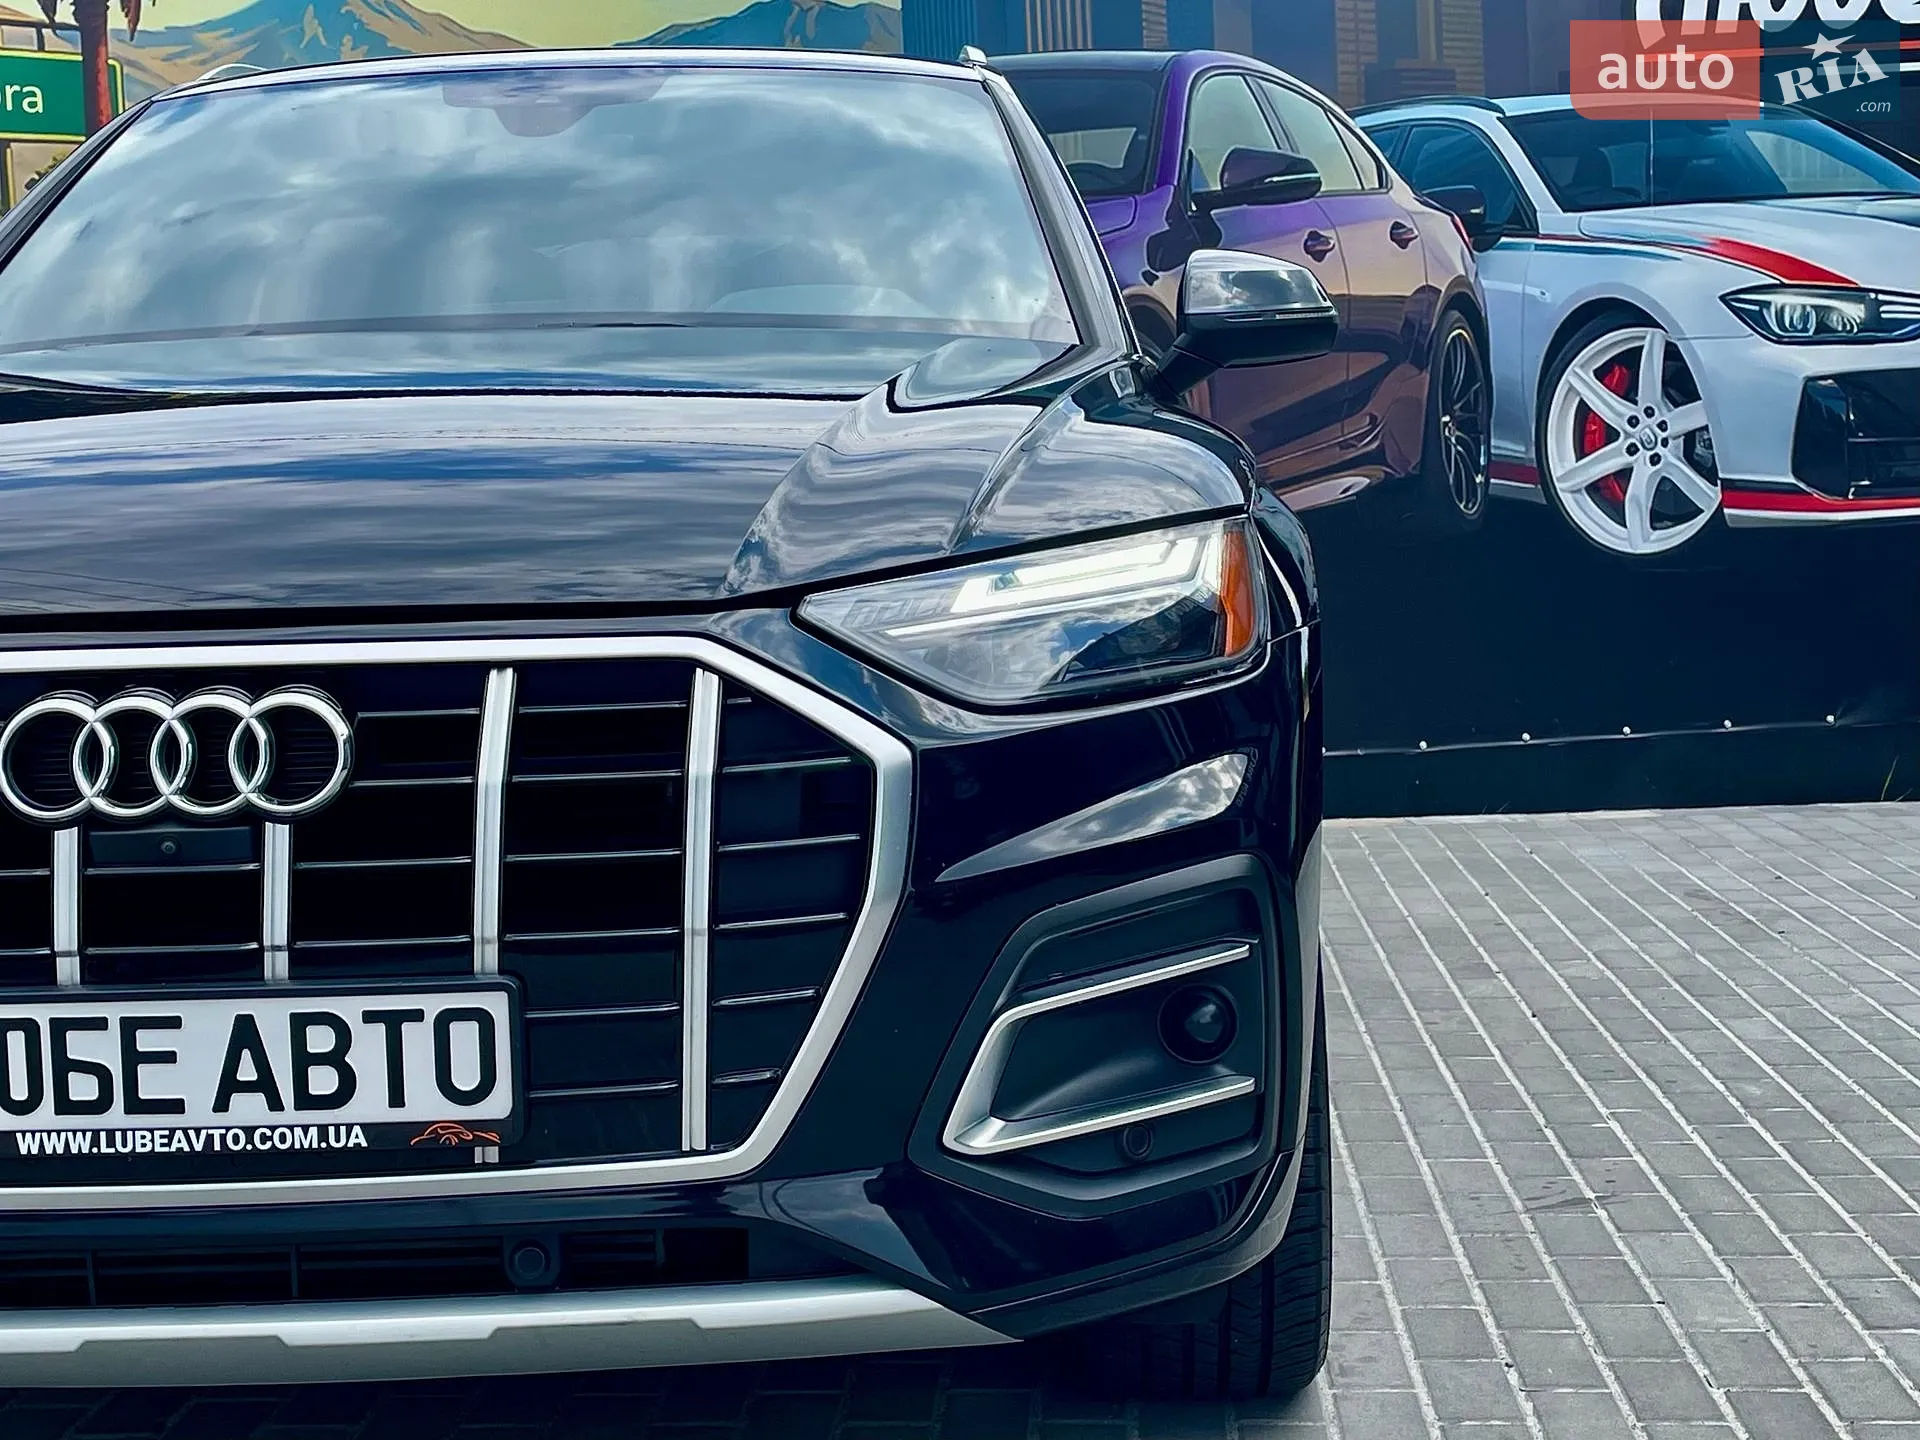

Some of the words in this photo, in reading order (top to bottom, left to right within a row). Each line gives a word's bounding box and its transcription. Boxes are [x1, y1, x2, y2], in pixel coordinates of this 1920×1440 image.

[0, 84, 44, 114] ra
[212, 1006, 497, 1114] АВТО
[16, 1124, 367, 1155] WWW.LUBEAVTO.COM.UA
